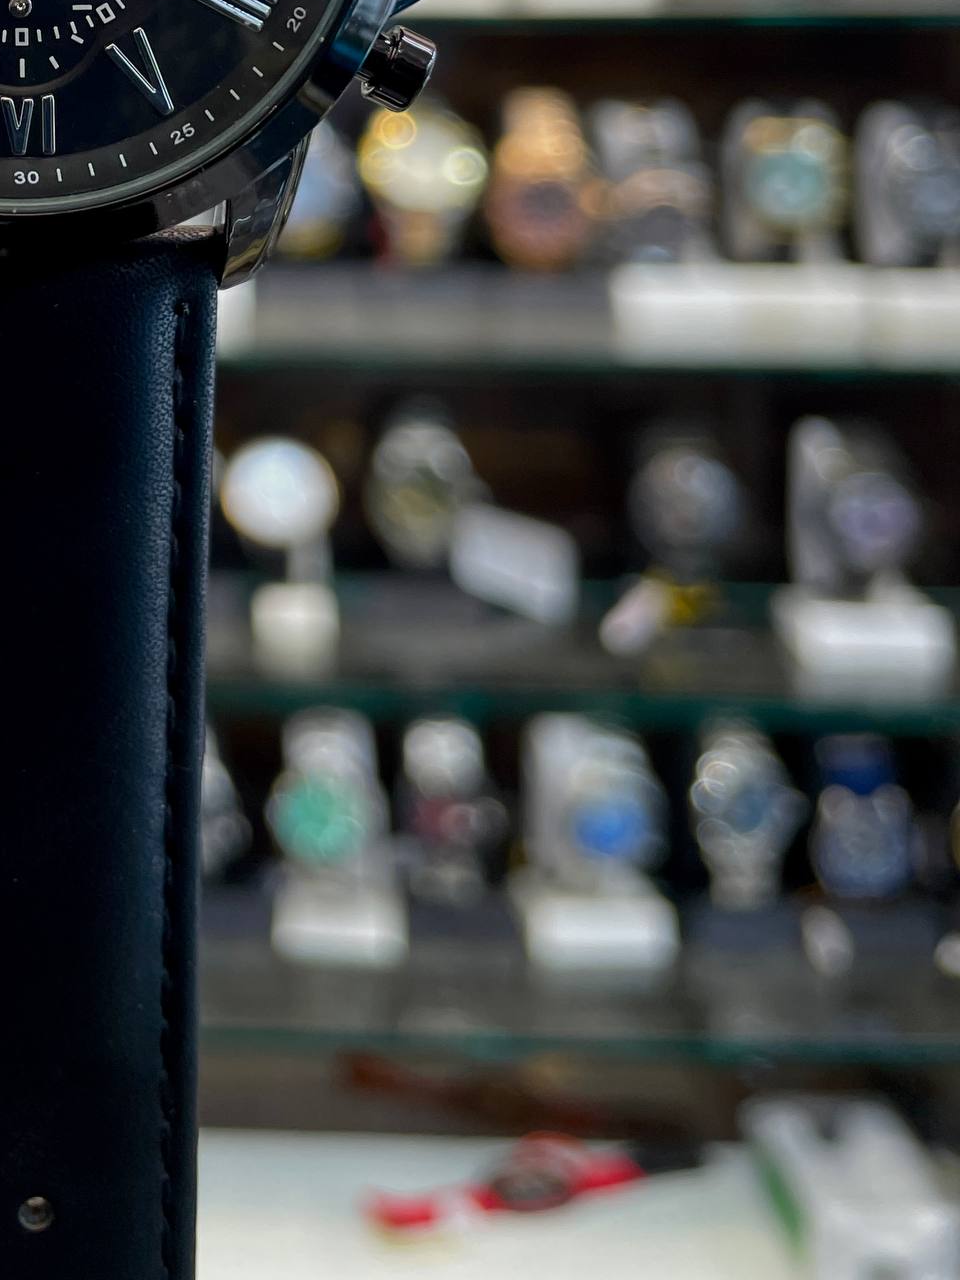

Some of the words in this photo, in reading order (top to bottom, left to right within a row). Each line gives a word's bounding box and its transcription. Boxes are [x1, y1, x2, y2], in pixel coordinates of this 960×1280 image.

[286, 6, 307, 33] 20
[105, 27, 174, 115] V
[0, 94, 56, 156] VI
[170, 123, 195, 145] 25
[14, 170, 40, 185] 30
